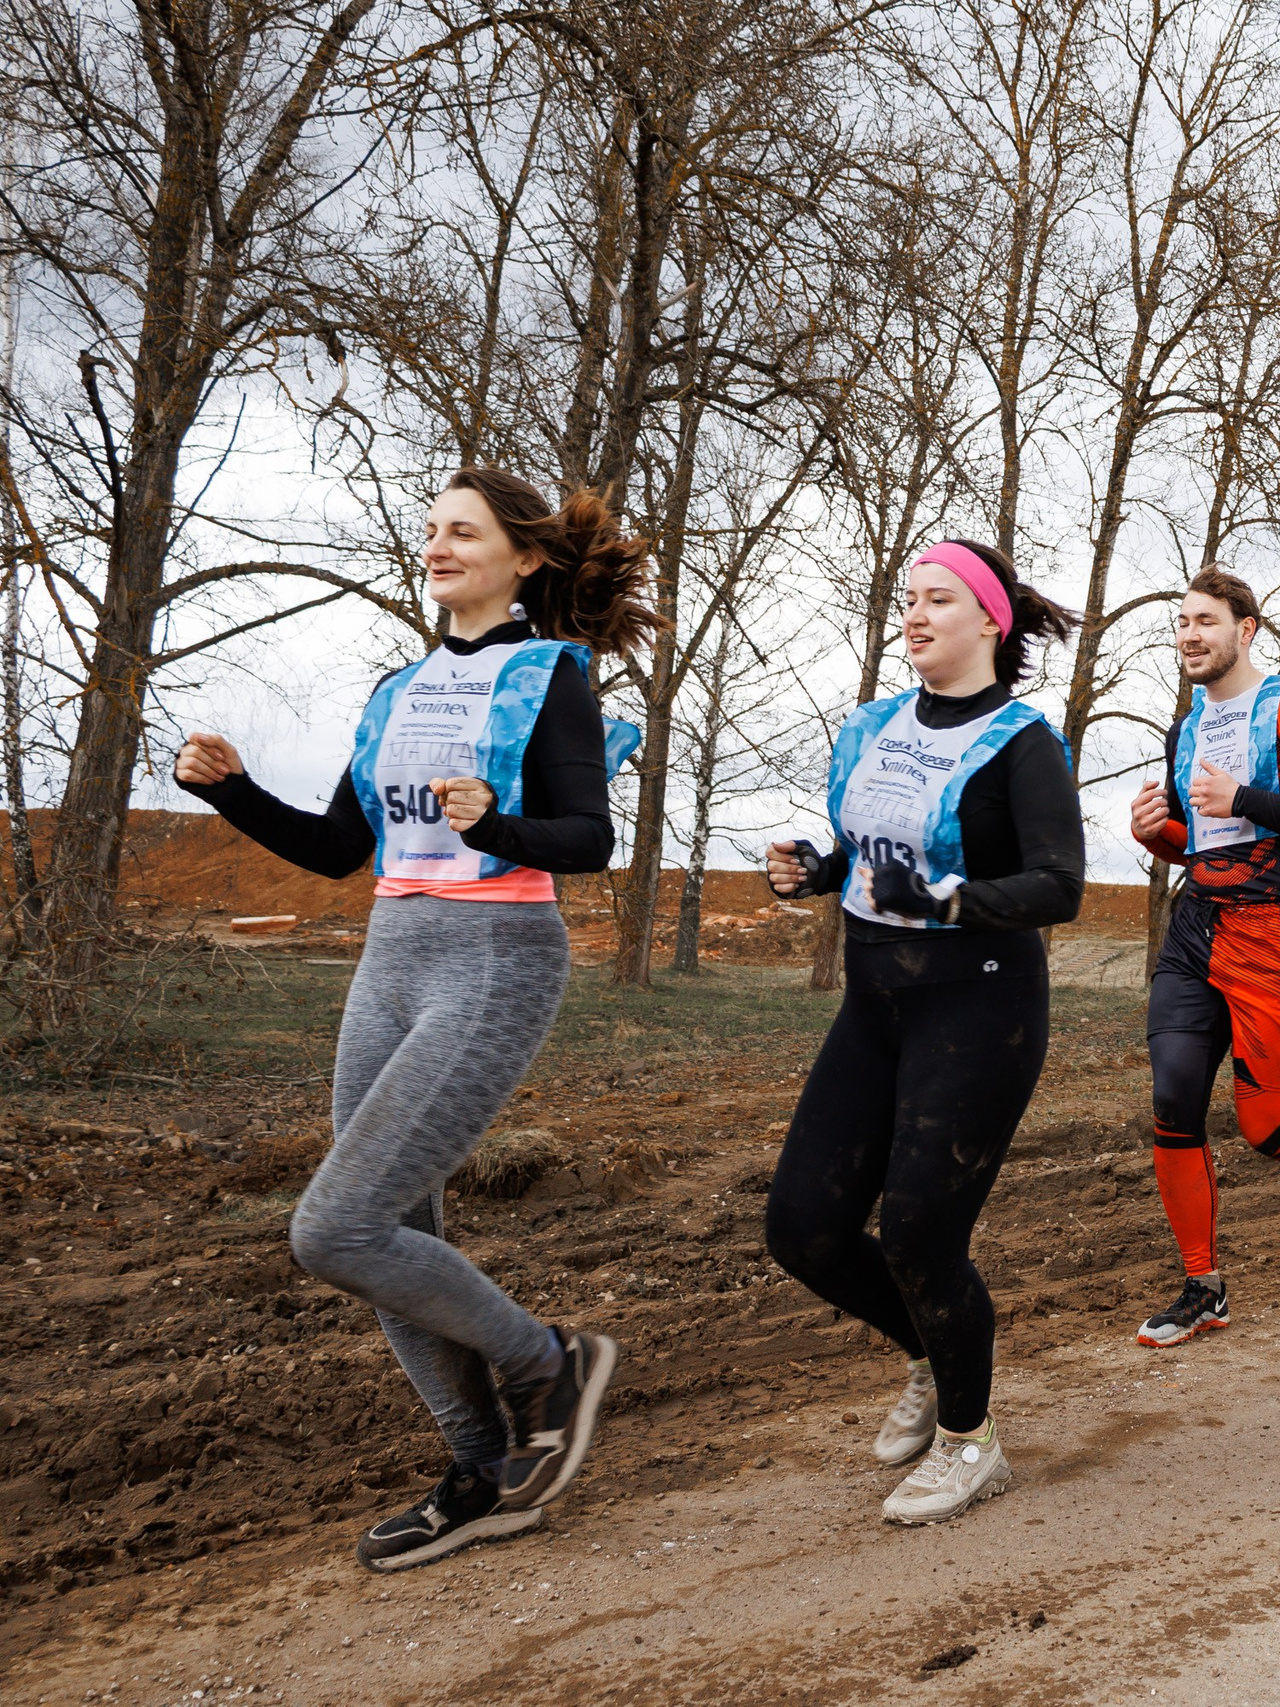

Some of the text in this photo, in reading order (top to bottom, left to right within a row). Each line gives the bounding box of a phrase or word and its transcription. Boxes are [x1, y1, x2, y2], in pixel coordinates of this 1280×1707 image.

[408, 682, 446, 692] ГОНКА
[406, 699, 473, 716] Sminex
[1205, 727, 1237, 746] Sminex
[879, 738, 956, 768] ГОНКА ГЕРОЕВ
[876, 757, 932, 786] Sminex
[385, 784, 449, 825] 540
